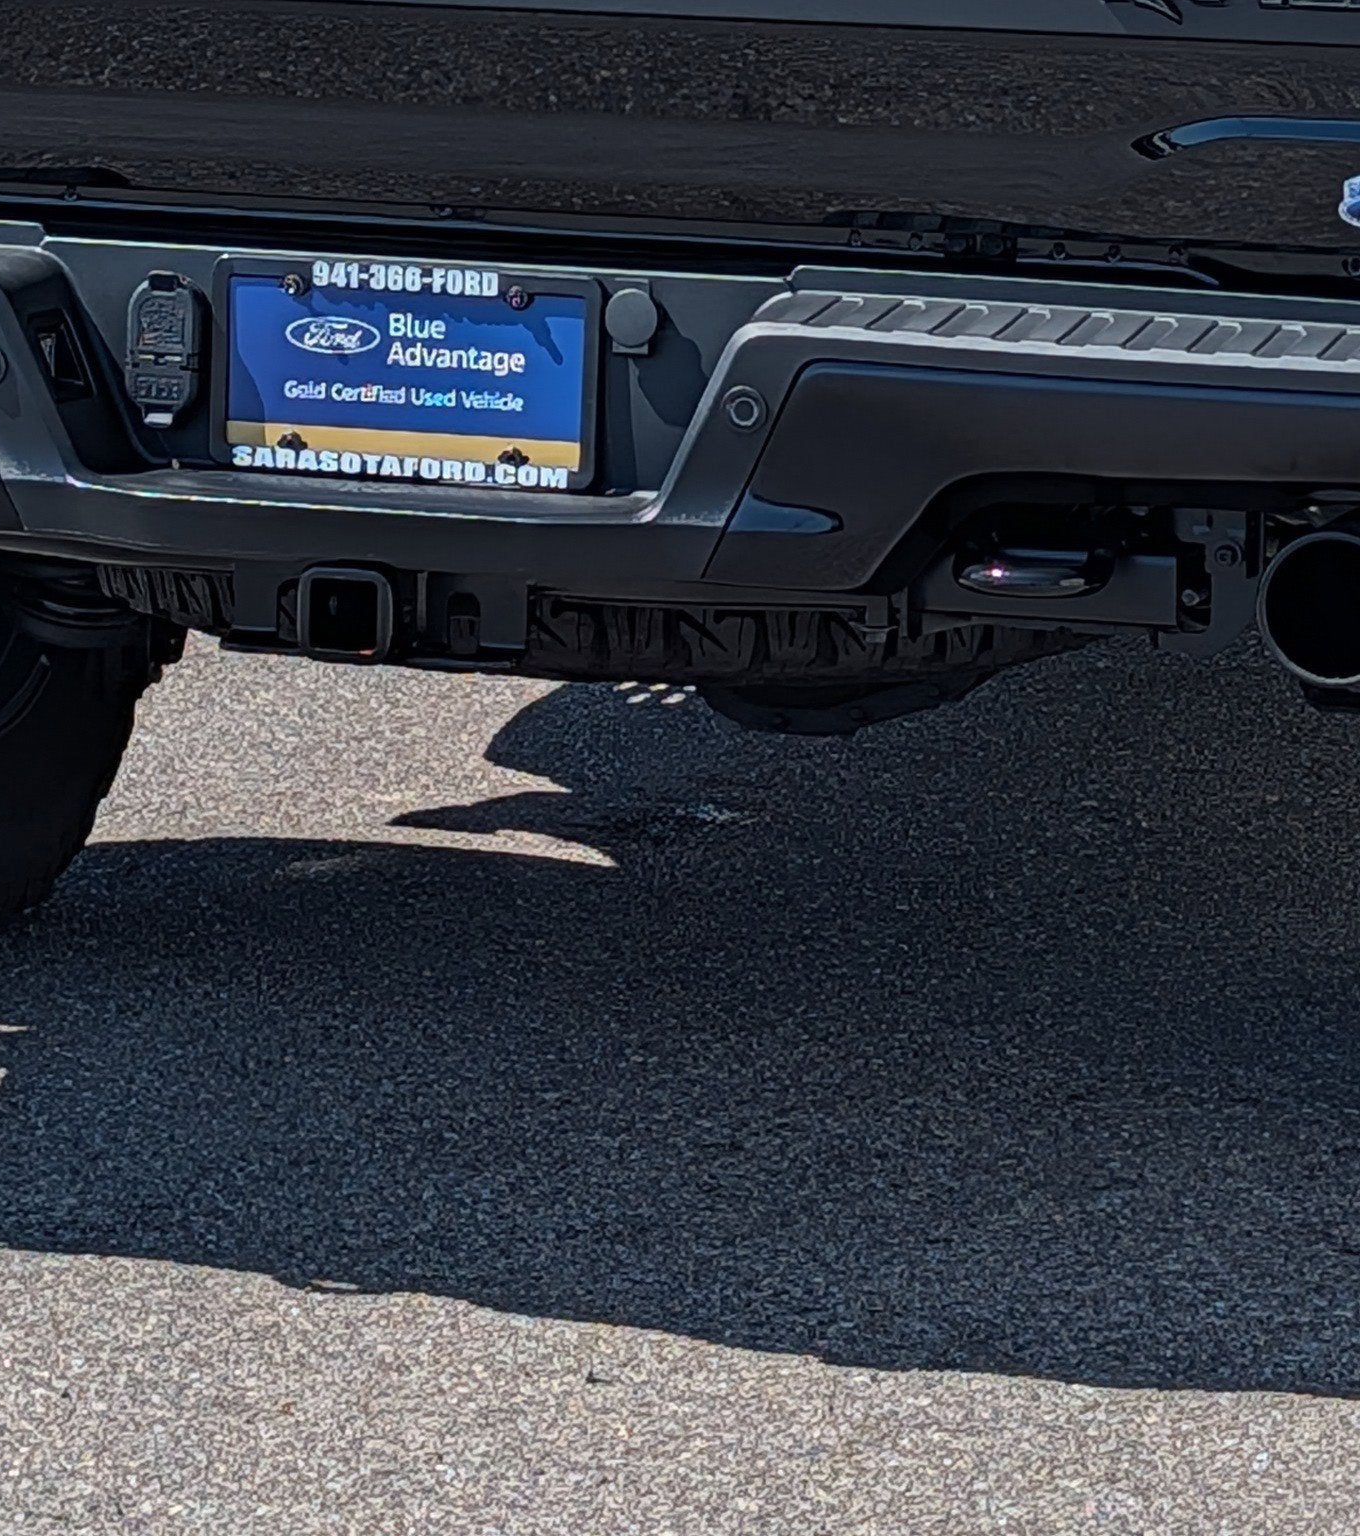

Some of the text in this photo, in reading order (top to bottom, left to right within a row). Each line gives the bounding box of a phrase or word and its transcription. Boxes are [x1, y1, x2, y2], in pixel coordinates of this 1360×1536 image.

[312, 260, 499, 297] 941-366-FORD
[301, 320, 361, 350] Ford
[389, 312, 446, 340] Blue
[387, 341, 525, 376] Advantage
[284, 379, 524, 412] Gold Certified Used Vehicle
[232, 444, 568, 490] SARASOTAFORD.COM
